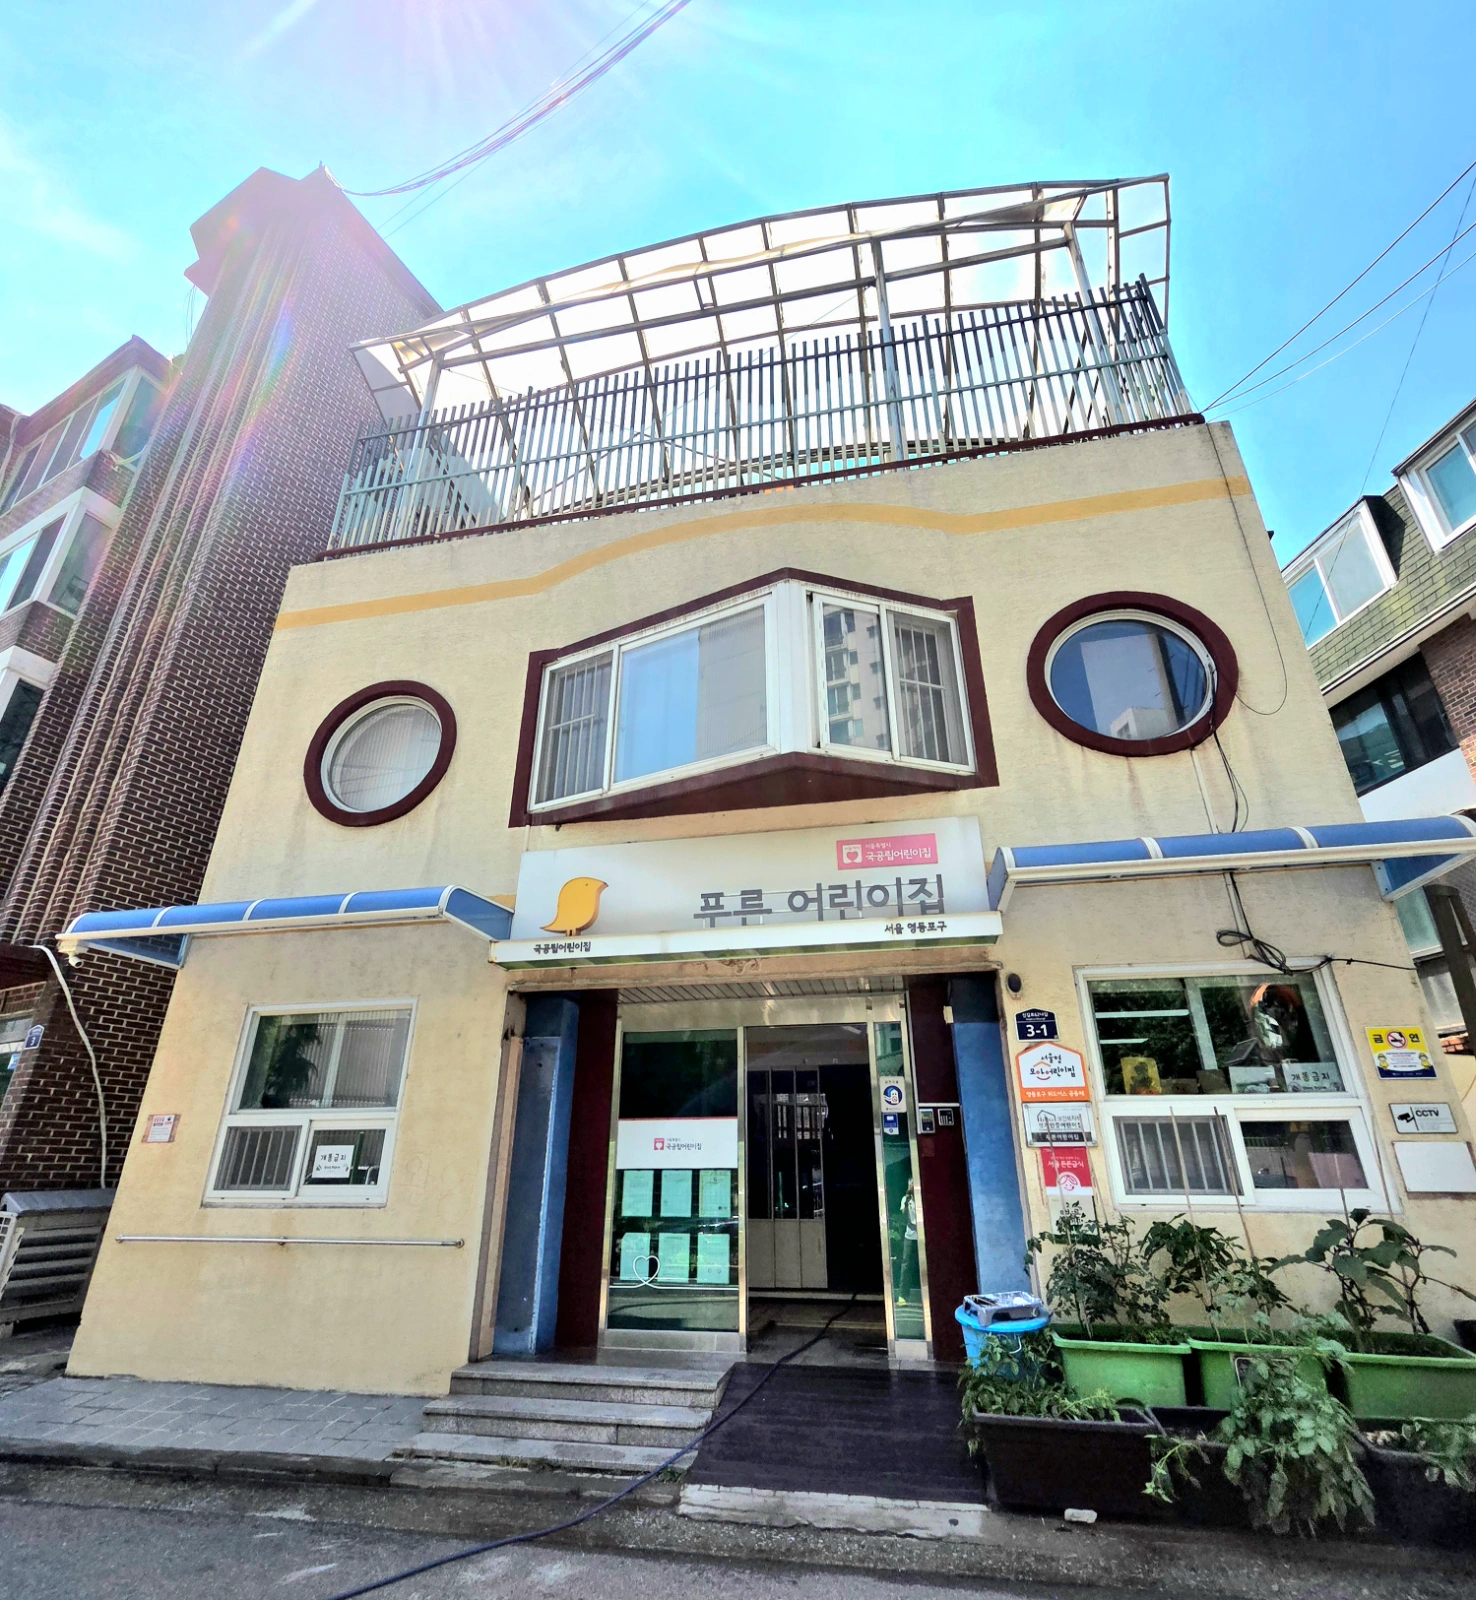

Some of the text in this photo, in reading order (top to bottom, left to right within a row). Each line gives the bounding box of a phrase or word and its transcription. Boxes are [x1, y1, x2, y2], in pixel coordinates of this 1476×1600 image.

[865, 847, 932, 862] 국공립어린이집
[693, 874, 945, 928] 푸른 어린이집
[884, 921, 948, 935] 서울 영등포구
[533, 941, 592, 955] 국공립어린이집
[1025, 1024, 1048, 1037] 3-1
[1415, 1109, 1439, 1117] CCTV
